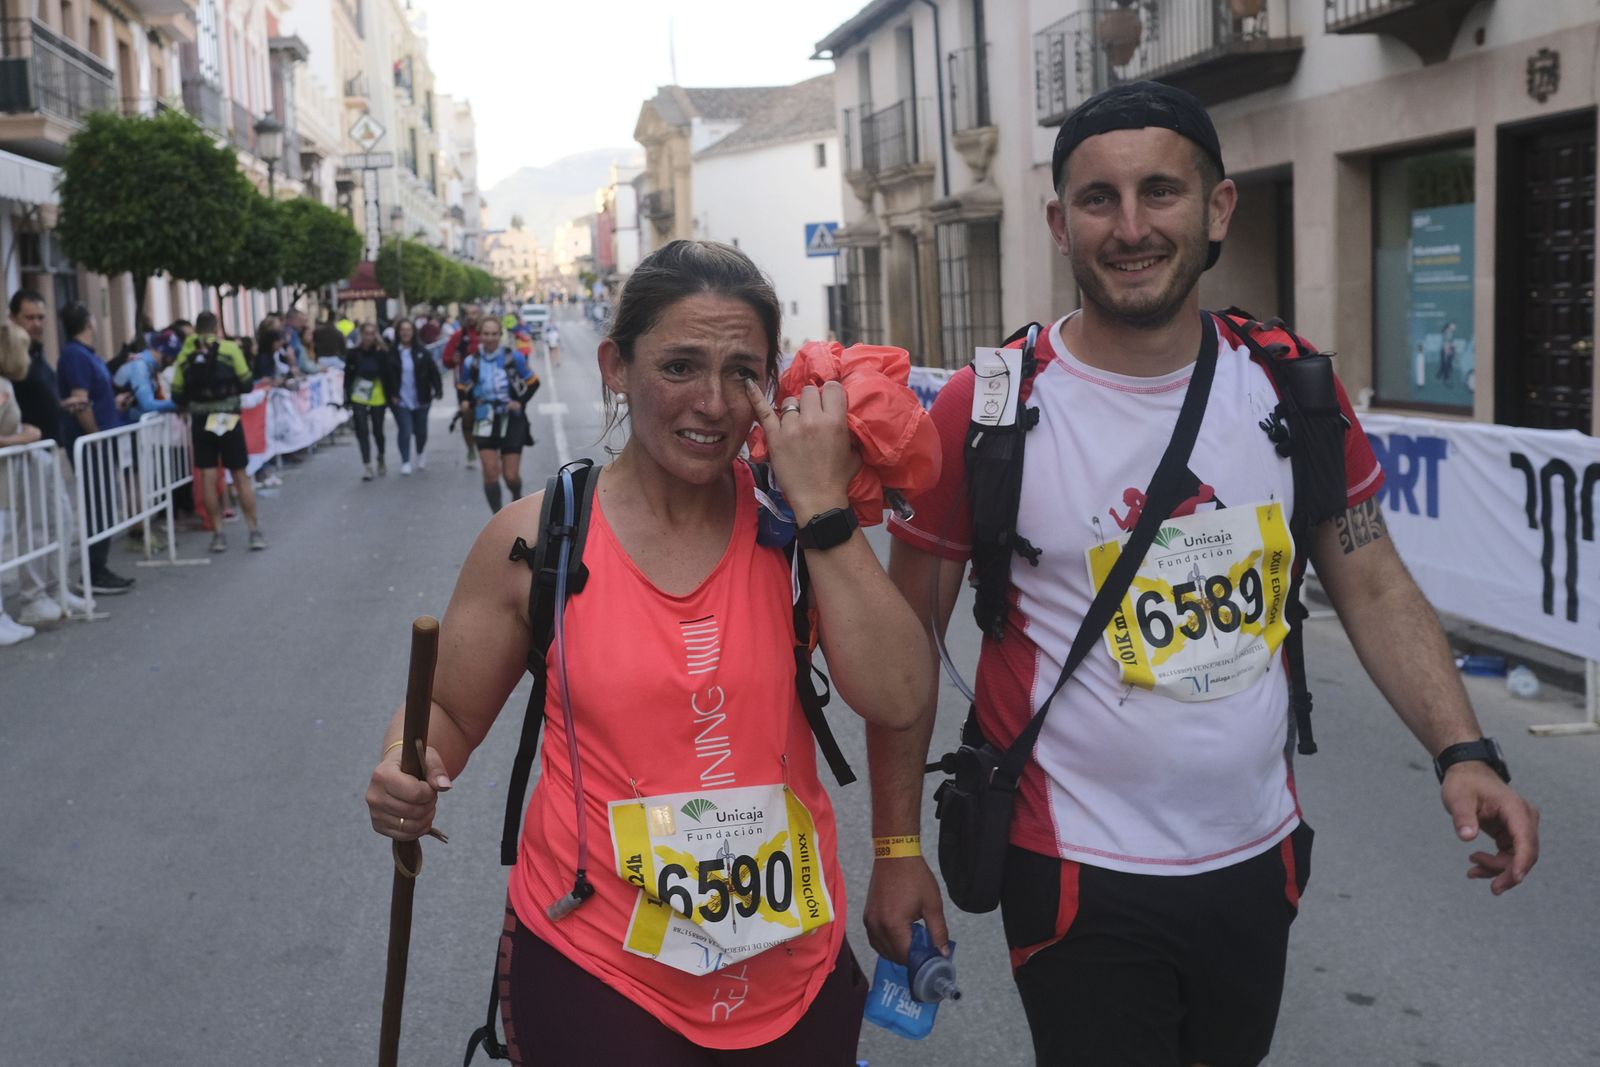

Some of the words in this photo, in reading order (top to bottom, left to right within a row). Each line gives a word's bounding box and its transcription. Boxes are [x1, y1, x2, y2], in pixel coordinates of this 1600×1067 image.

[1184, 529, 1233, 547] Unicaja
[1157, 548, 1234, 569] Fundación
[1270, 550, 1283, 575] XXIII
[1136, 567, 1264, 649] 6589
[716, 806, 764, 822] Unicaja
[687, 826, 763, 842] Fundación
[798, 833, 810, 862] XXIII
[658, 850, 793, 923] 6590
[802, 866, 820, 918] EDICIÓN
